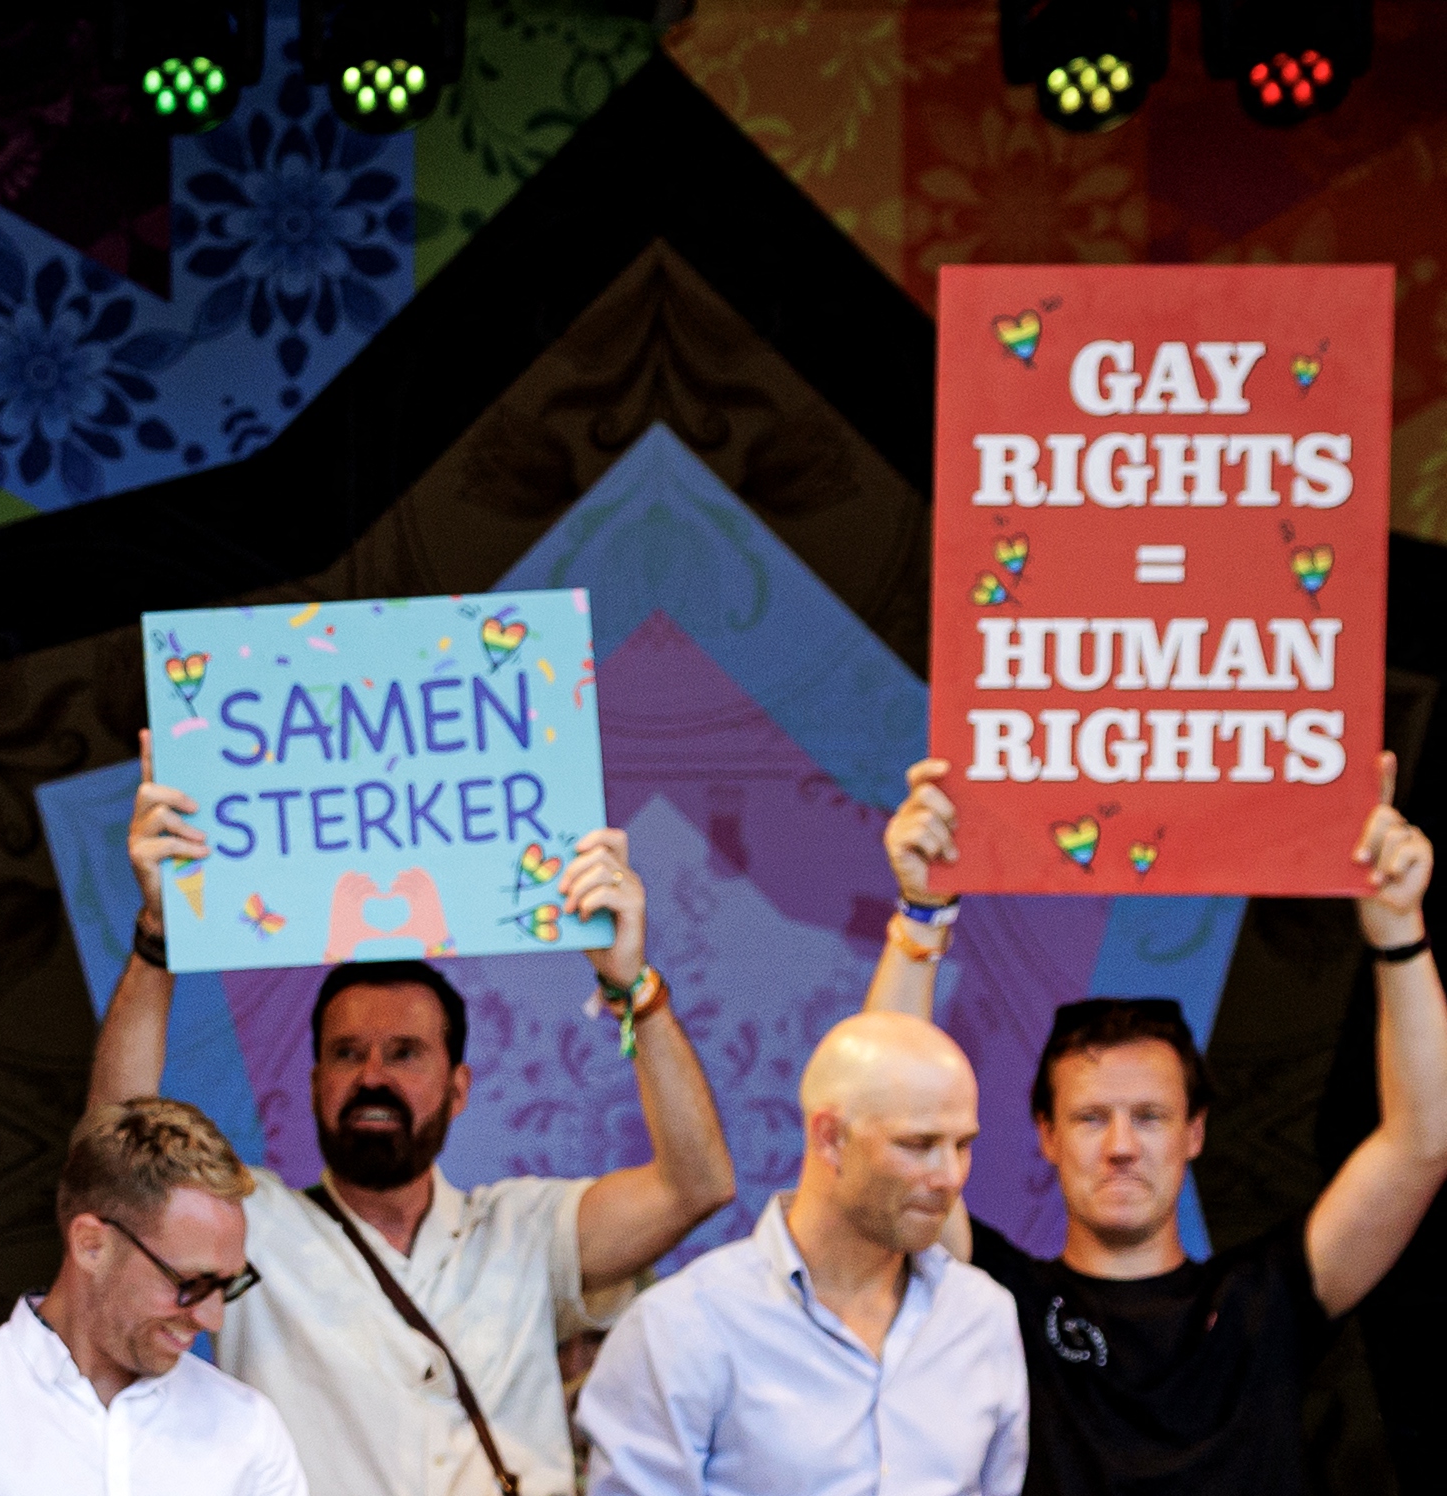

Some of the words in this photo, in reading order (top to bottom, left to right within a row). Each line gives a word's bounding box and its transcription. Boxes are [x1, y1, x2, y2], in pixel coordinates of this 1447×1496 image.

[1071, 341, 1265, 415] GAY
[972, 433, 1354, 508] RIGHTS
[1136, 545, 1186, 583] =
[976, 618, 1343, 692] HUMAN
[220, 672, 531, 767] SAMEN
[966, 708, 1347, 785] RIGHTS
[215, 773, 550, 858] STERKER
